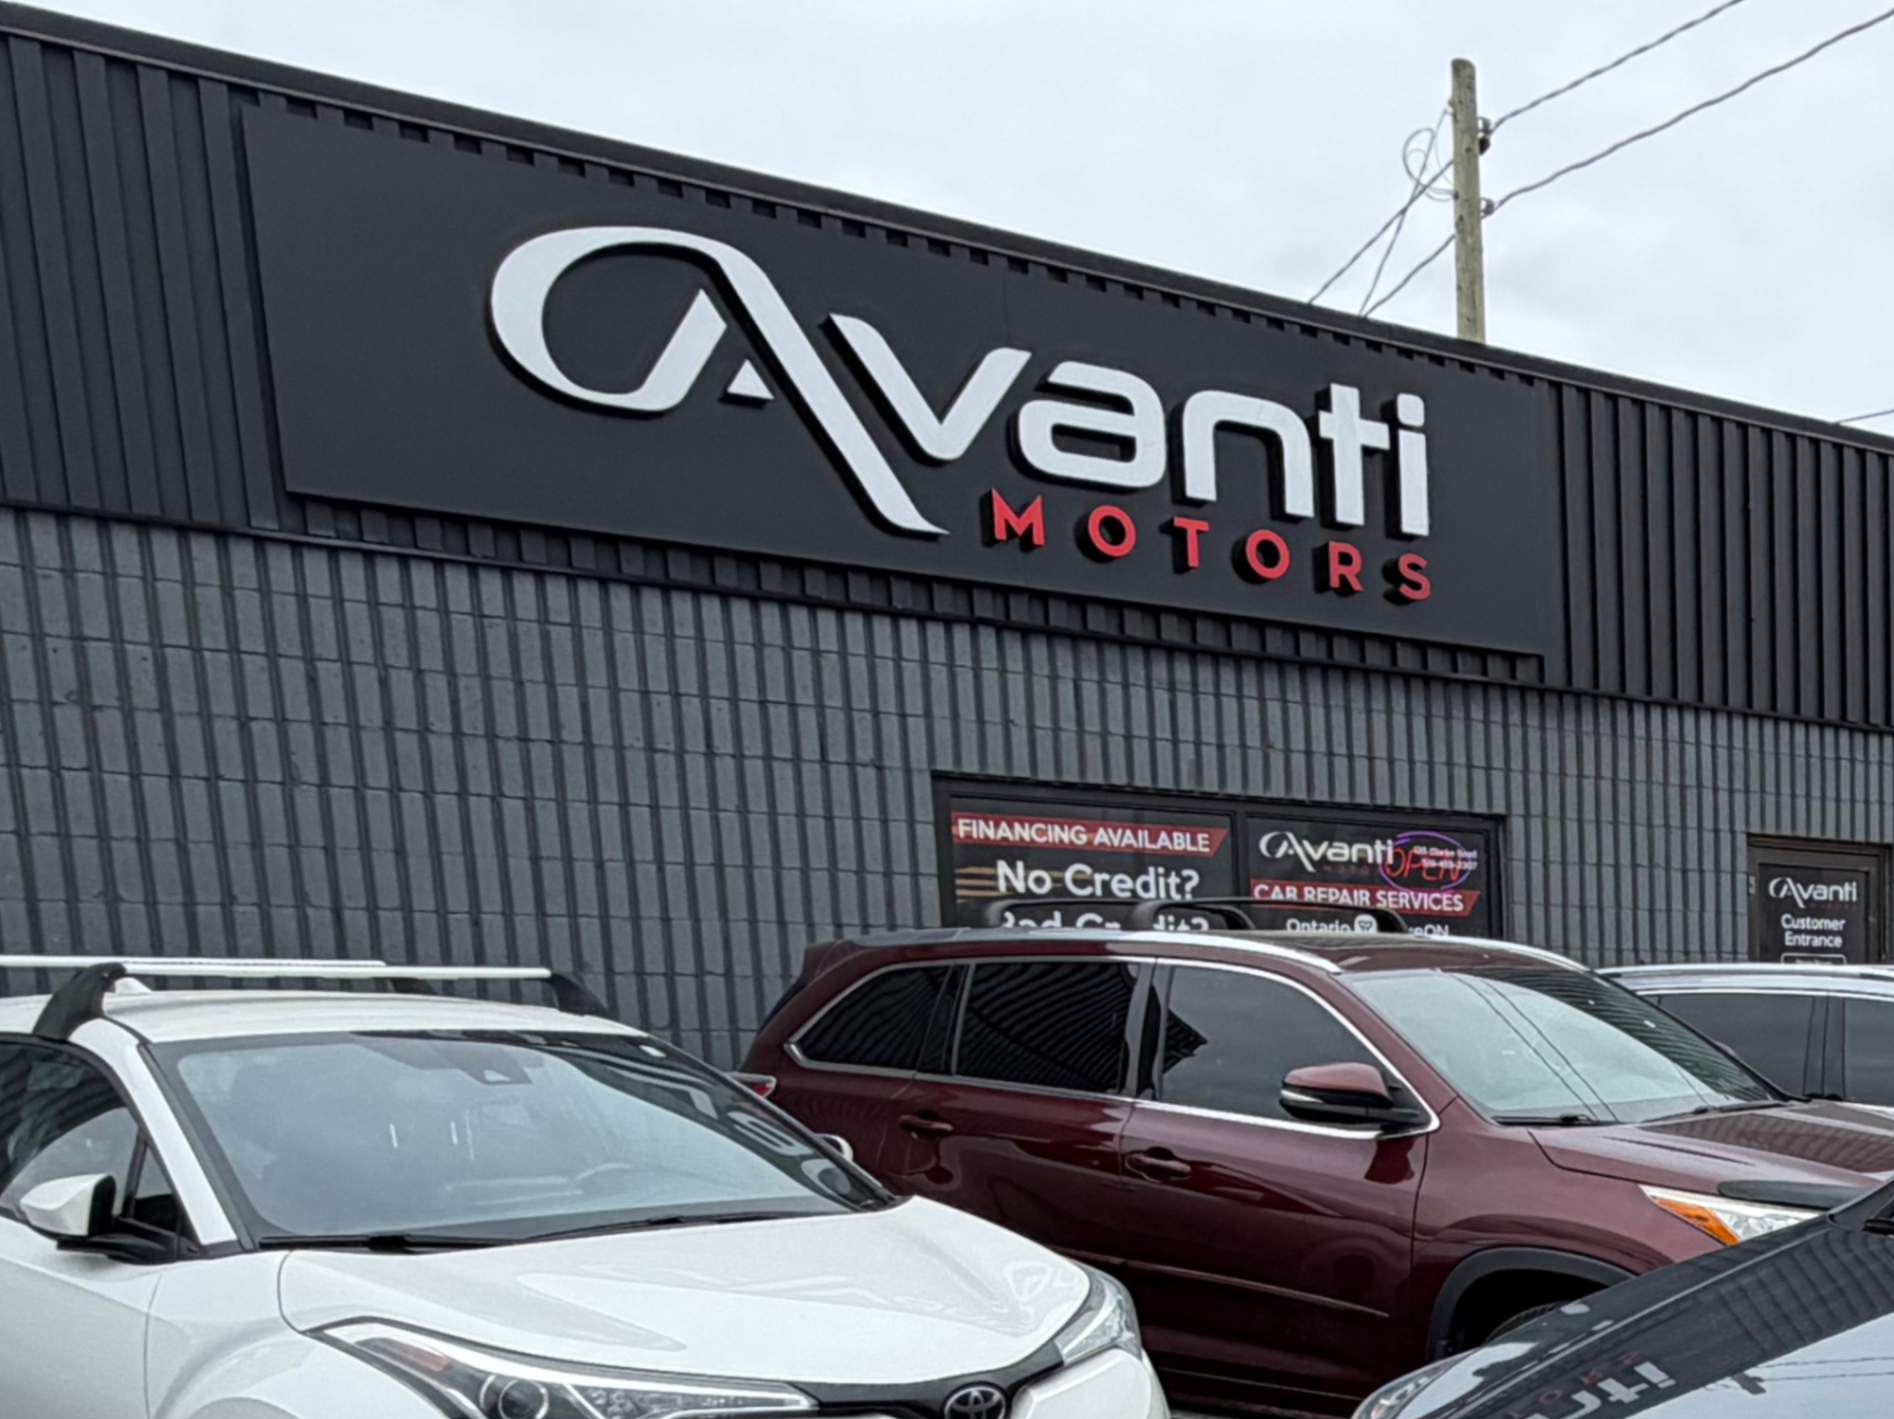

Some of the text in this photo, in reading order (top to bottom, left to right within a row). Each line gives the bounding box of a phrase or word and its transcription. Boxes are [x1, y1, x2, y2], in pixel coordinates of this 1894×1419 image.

[490, 226, 1429, 536] Avanti
[991, 488, 1430, 602] MOTORS
[957, 819, 1211, 852] FINANCING AVAILABLE
[1258, 830, 1394, 873] Avanti
[995, 859, 1200, 900] No Credit?
[1768, 877, 1858, 909] Avanti
[1254, 884, 1464, 912] CAR REPAIR SERVICES
[1286, 918, 1351, 932] Ontario
[1780, 913, 1847, 931] Customer
[1784, 931, 1843, 948] Entrance
